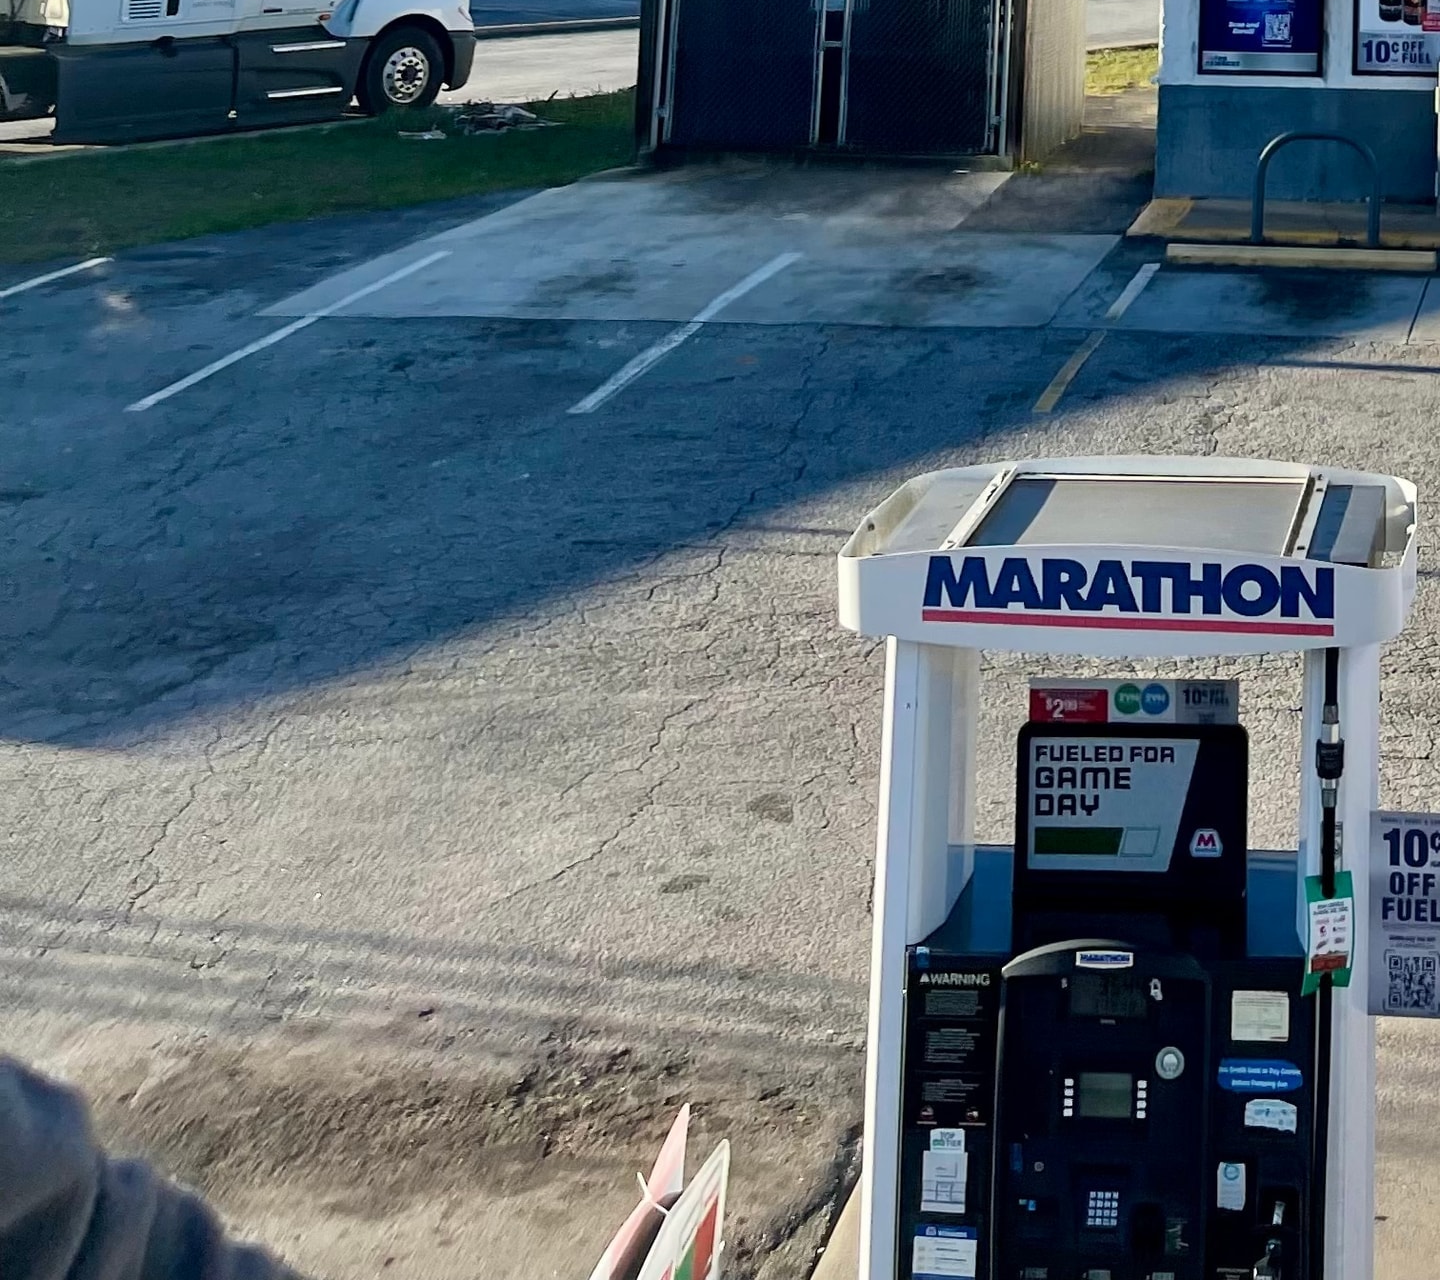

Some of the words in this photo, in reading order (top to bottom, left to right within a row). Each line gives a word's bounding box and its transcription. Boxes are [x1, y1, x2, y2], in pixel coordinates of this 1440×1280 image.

[1402, 41, 1424, 53] OFF
[1402, 53, 1432, 64] FUEL
[921, 555, 1335, 620] MARATHON
[1035, 745, 1123, 762] FUELED
[1130, 746, 1175, 763] FOR
[1035, 766, 1131, 789] GAME
[1035, 794, 1099, 816] DAY
[1389, 872, 1436, 896] OFF
[930, 973, 990, 985] WARNING
[940, 1131, 955, 1140] TOP
